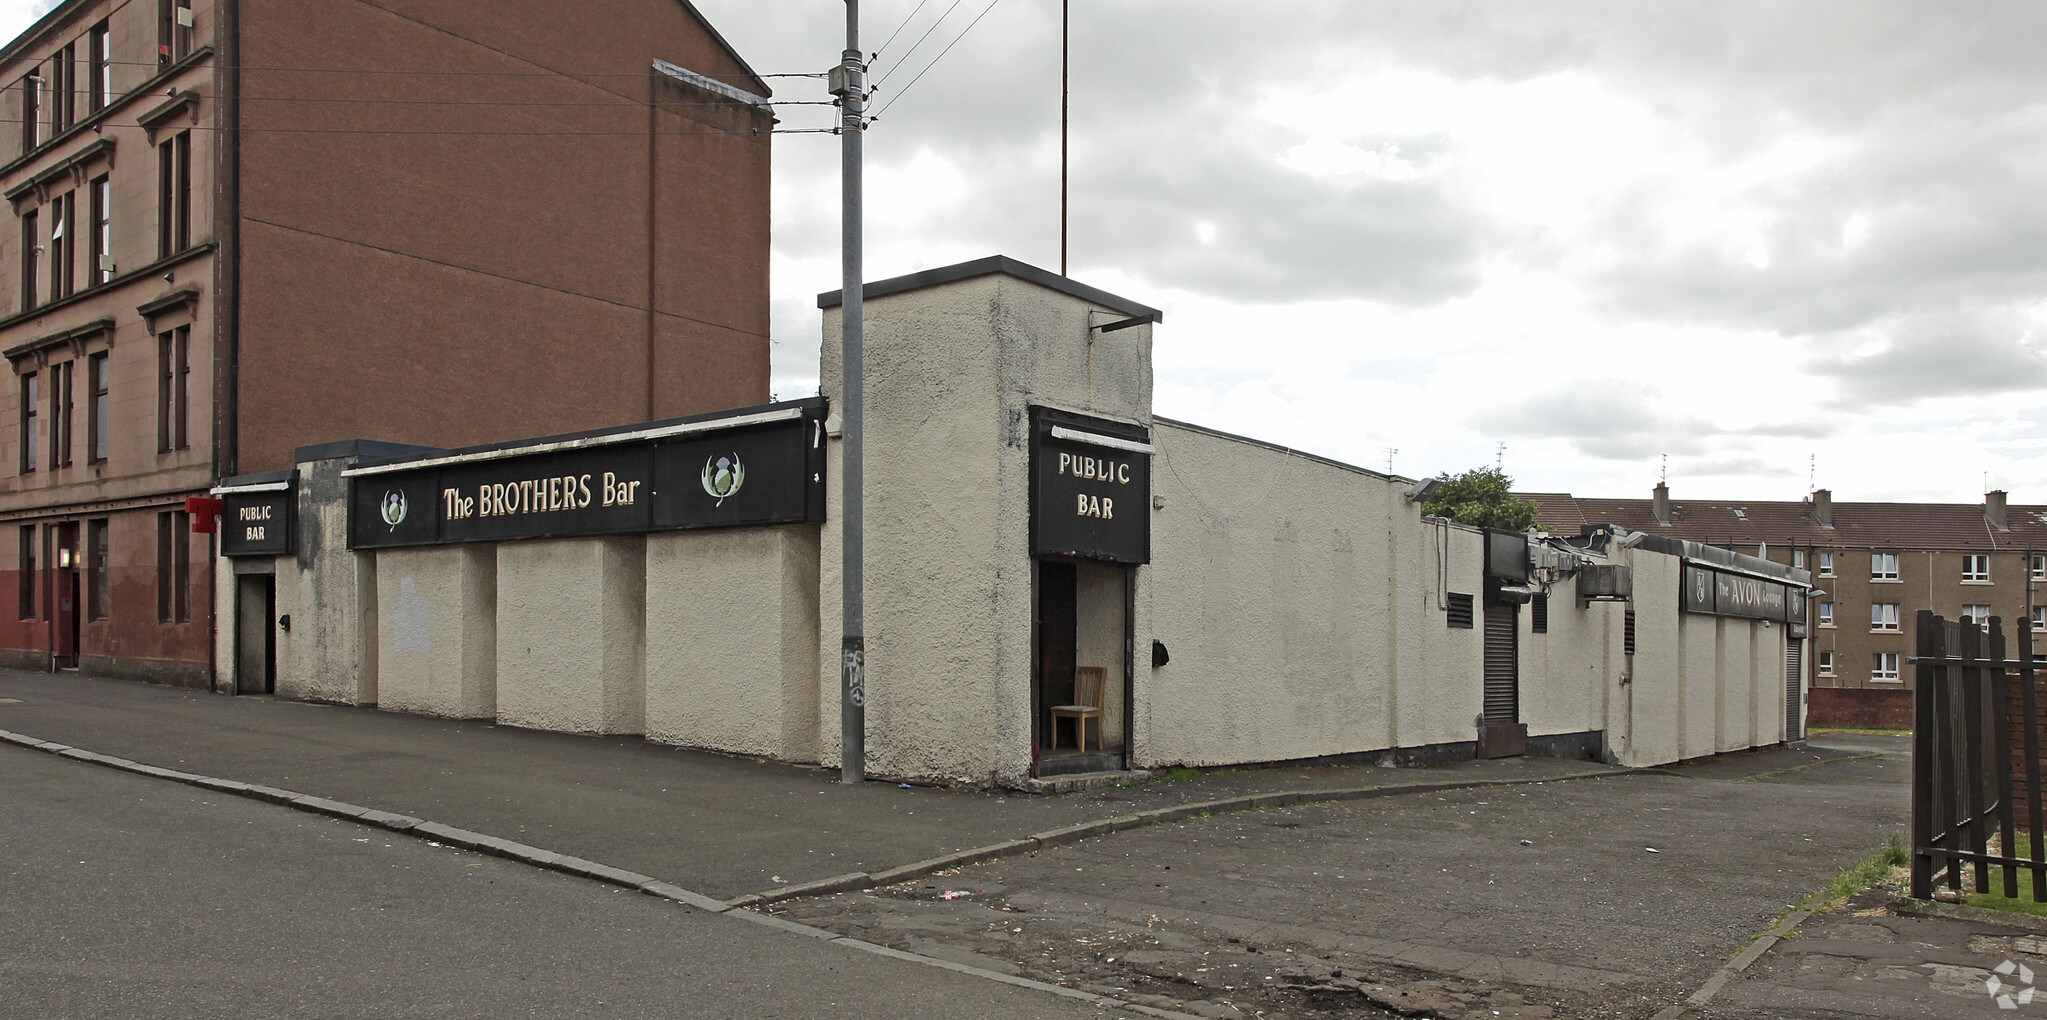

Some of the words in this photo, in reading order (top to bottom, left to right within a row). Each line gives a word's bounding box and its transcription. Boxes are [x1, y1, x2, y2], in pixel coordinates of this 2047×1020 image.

[1058, 452, 1130, 485] PUBLIC
[443, 487, 474, 520] The
[479, 473, 592, 517] BROTHERS
[602, 471, 641, 507] Bar
[1077, 493, 1113, 519] BAR
[240, 505, 272, 520] PUBLIC
[246, 526, 265, 540] BAR
[1718, 582, 1729, 597] The
[1732, 579, 1761, 607] AVON
[1762, 589, 1781, 607] Lounge
